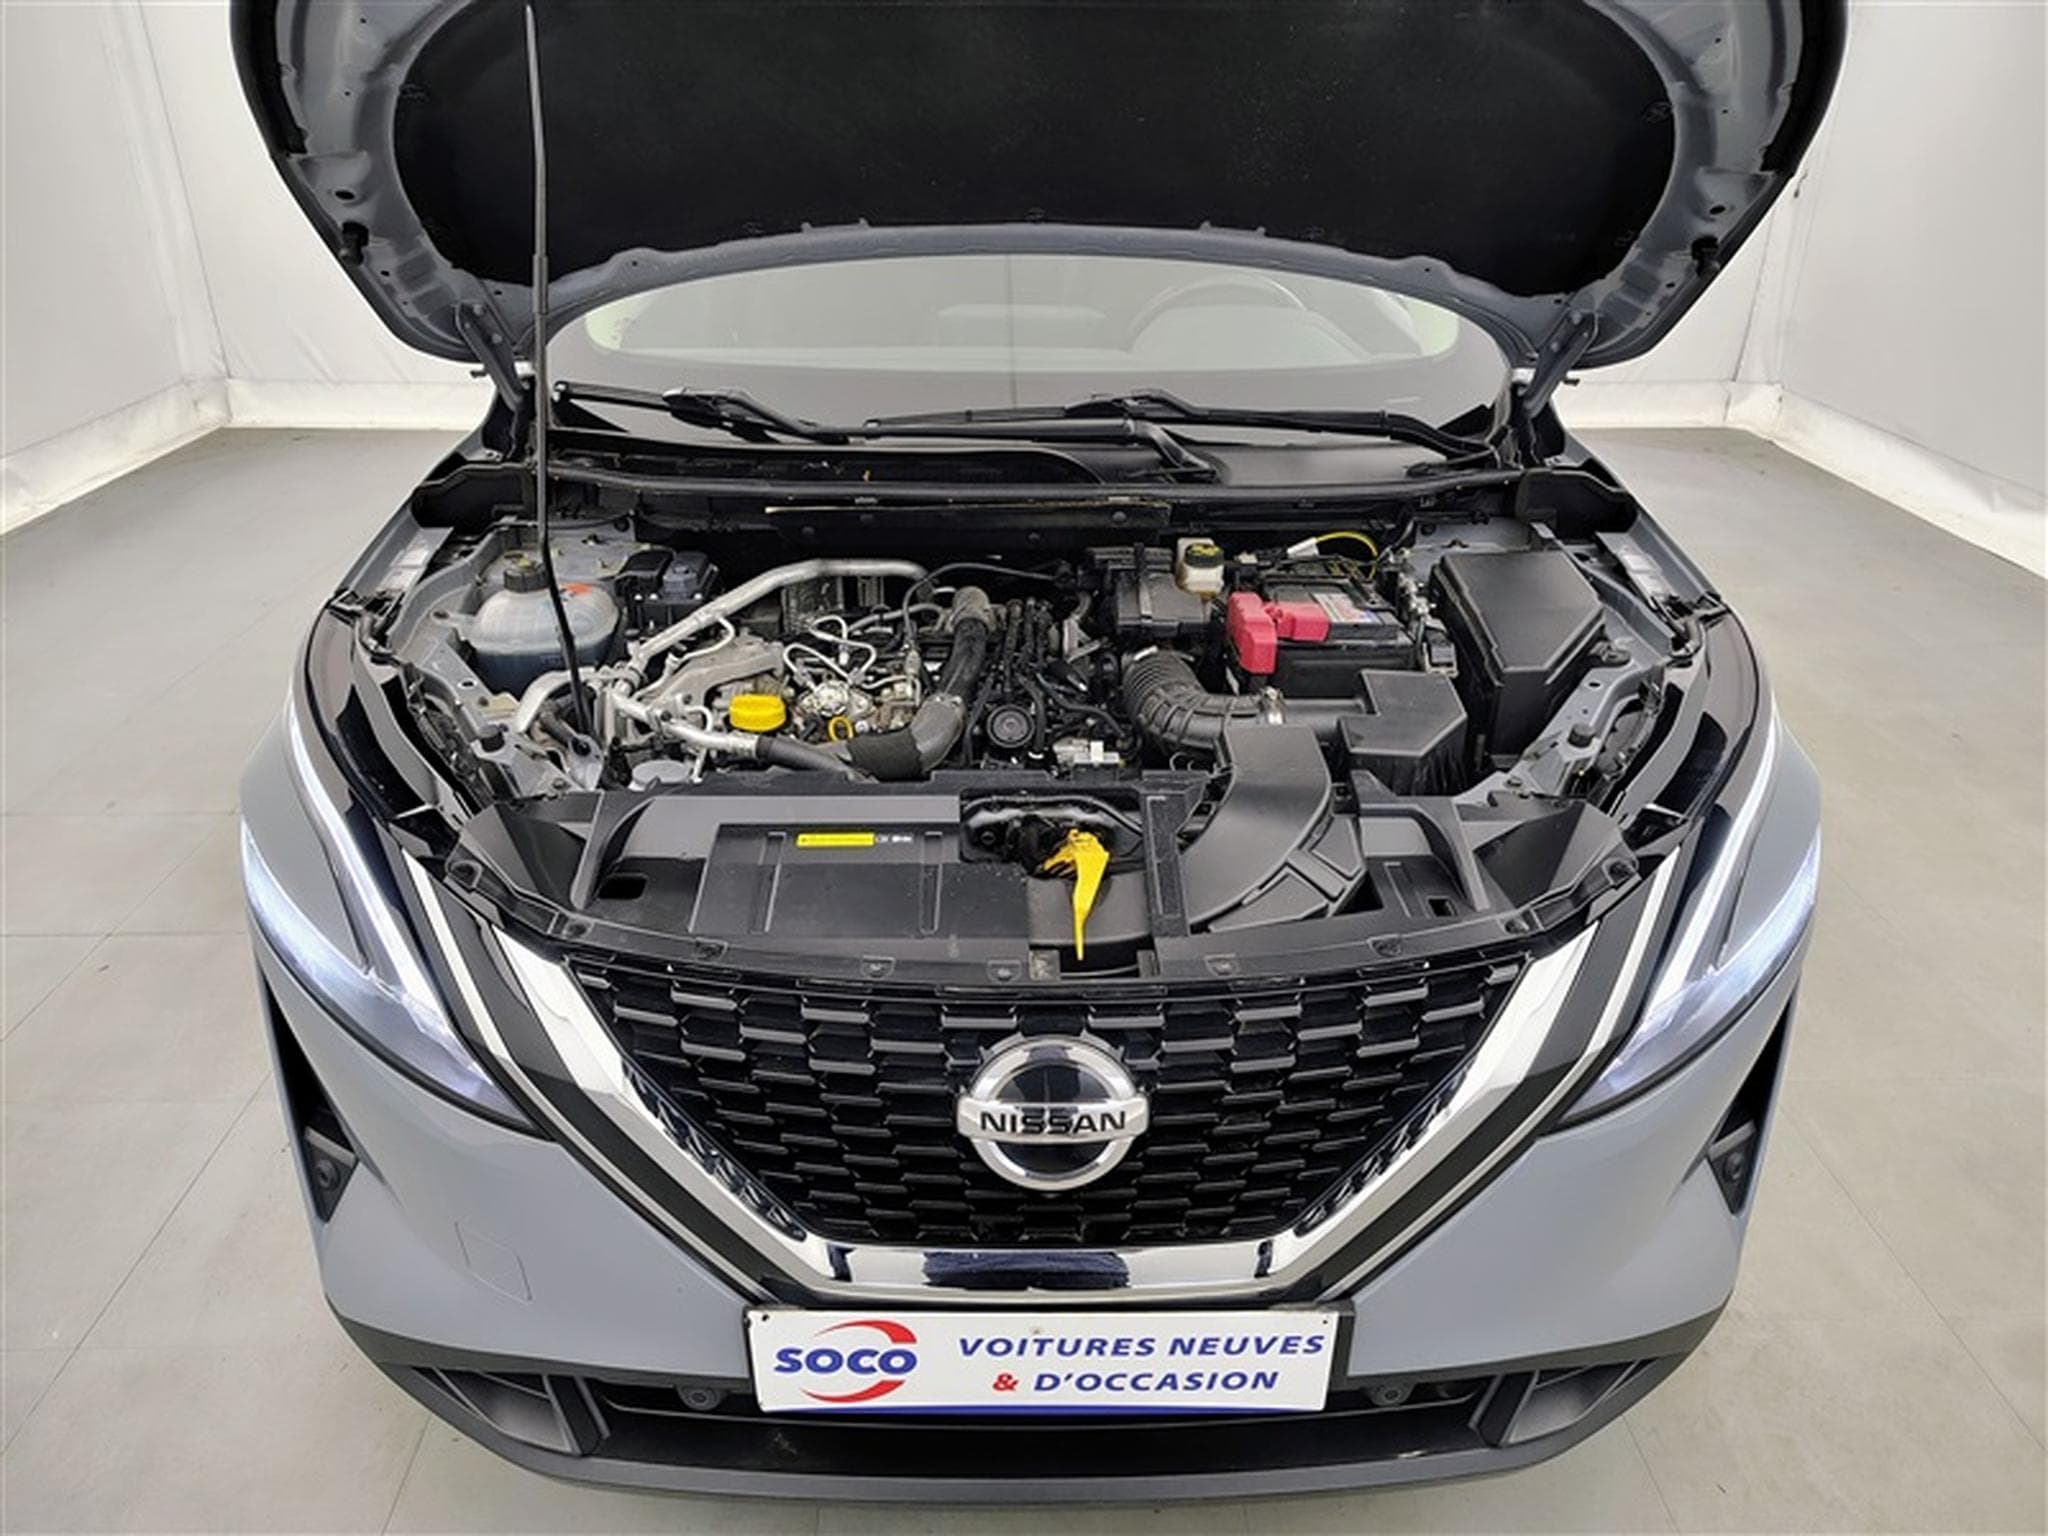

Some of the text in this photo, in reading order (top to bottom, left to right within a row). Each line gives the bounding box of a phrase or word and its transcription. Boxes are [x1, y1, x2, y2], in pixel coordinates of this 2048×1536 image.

[980, 1111, 1126, 1135] NISSAN
[959, 1335, 1325, 1357] VOITURES NEUVES
[774, 1347, 918, 1375] SOCO
[992, 1371, 1279, 1392] & D'OCCASION
